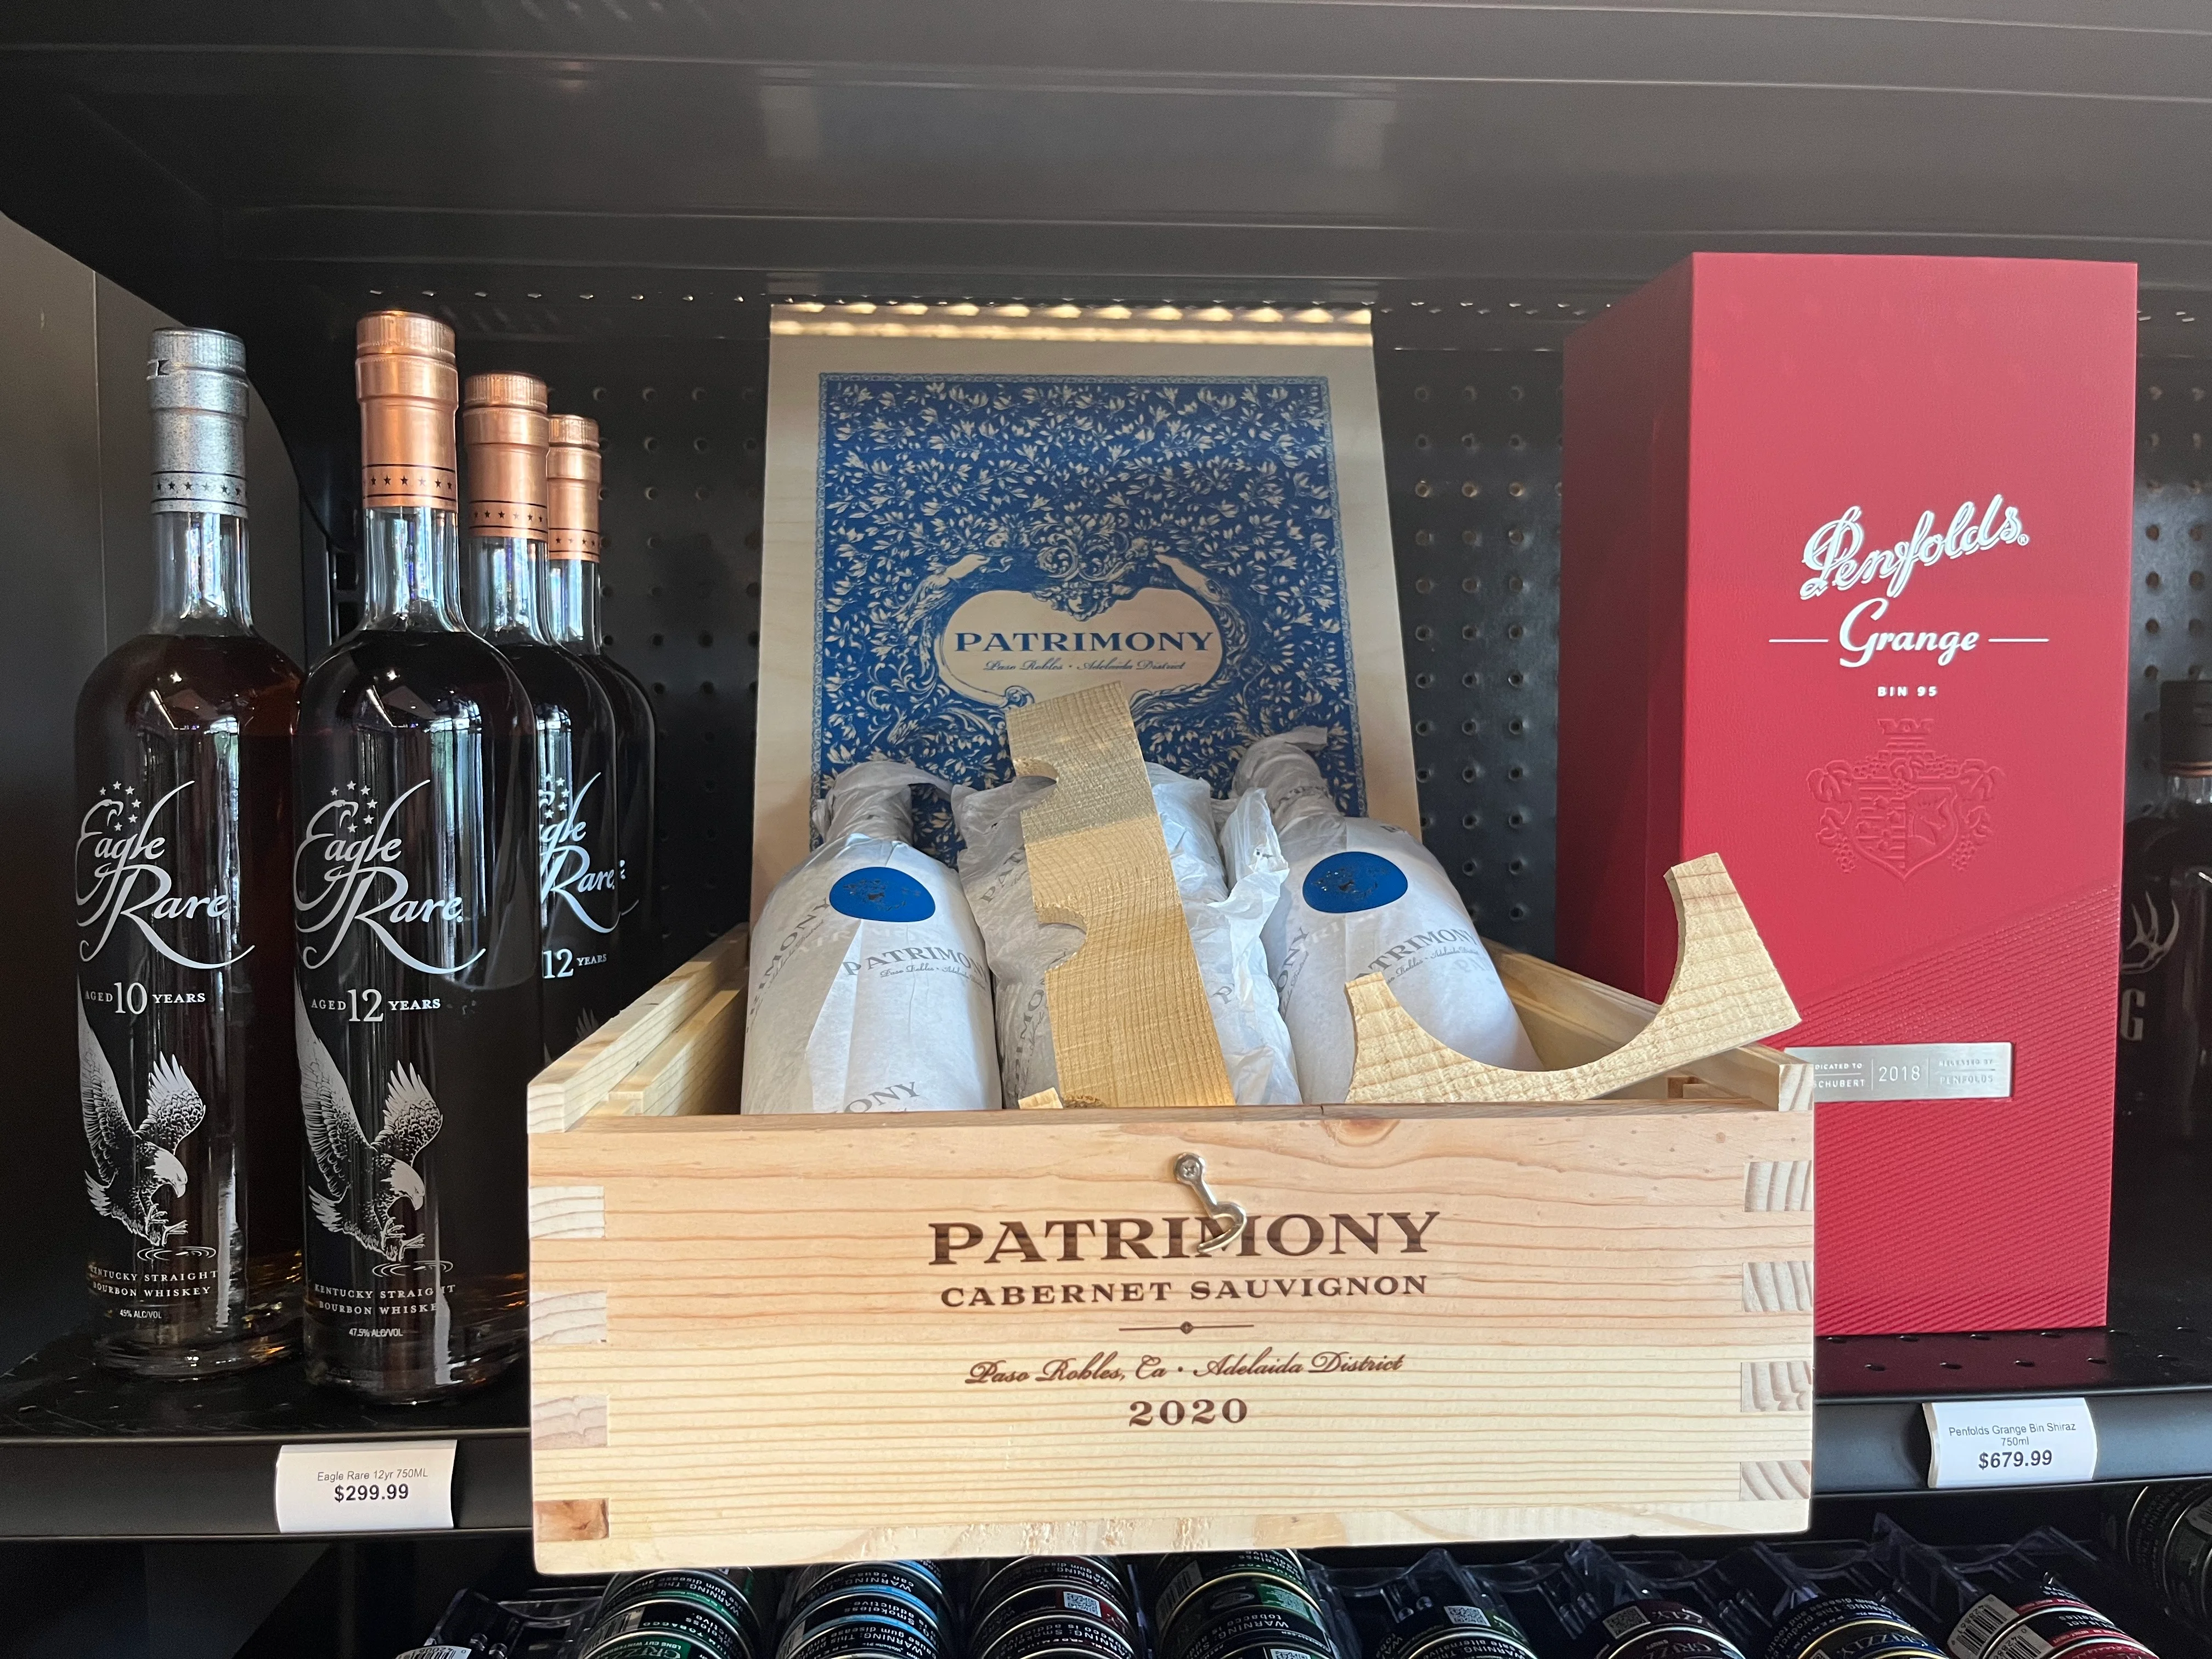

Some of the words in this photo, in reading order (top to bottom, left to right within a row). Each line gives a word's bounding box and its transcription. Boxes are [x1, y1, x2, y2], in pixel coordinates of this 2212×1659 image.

[1799, 493, 2024, 600] Penfolds
[955, 631, 1214, 652] PATRIMONY
[1839, 597, 1980, 668] Grange
[983, 660, 1017, 671] Paso
[1019, 657, 1063, 670] Robles
[1877, 686, 1908, 697] BIN
[1917, 686, 1938, 697] 95
[75, 780, 195, 927] Eagle
[293, 779, 431, 933] Eagle
[80, 864, 256, 969] Rare
[302, 865, 486, 974] Rare
[542, 948, 574, 979] 12
[576, 953, 608, 967] YEARS
[84, 991, 114, 1003] AGED
[114, 981, 148, 1014] 10
[152, 992, 206, 1004] YEARS
[311, 998, 347, 1011] AGED
[347, 989, 384, 1022] 12
[388, 998, 441, 1011] YEARS
[1878, 1065, 1921, 1082] 2018
[1940, 1075, 1993, 1085] PENFOLDS
[927, 1210, 1440, 1266] PATRIMONY
[88, 1263, 138, 1281] KENTUCKY
[144, 1271, 218, 1282] STRAIGHT
[93, 1281, 137, 1296] BOURBON
[144, 1286, 211, 1297] WHISKEY
[314, 1283, 374, 1299] KENTUCKY
[941, 1282, 1172, 1308] CABERNET
[1190, 1275, 1428, 1300] SAUVIGNON
[119, 1308, 132, 1318] 45%
[319, 1300, 373, 1315] BOURBON
[379, 1302, 438, 1315] WHISKE
[965, 1359, 1029, 1385] Paso
[1035, 1351, 1125, 1383] Robles,
[1135, 1355, 1167, 1379] Ca
[1193, 1347, 1305, 1378] Adelaida
[1307, 1351, 1406, 1375] District
[1128, 1398, 1249, 1427] 2020
[1948, 1426, 1990, 1437] Penfolds
[1992, 1425, 2027, 1435] Grange
[2029, 1423, 2045, 1433] Bin
[2047, 1422, 2077, 1432] Shiraz
[2000, 1436, 2030, 1447] 750ml
[1978, 1449, 2053, 1471] $679.99
[317, 1471, 344, 1483] Eagle
[347, 1470, 370, 1480] Rare
[374, 1469, 394, 1481] 12yr
[396, 1468, 429, 1479] 750ML
[334, 1483, 409, 1503] $299.99
[881, 1627, 905, 1638] gum
[860, 1632, 923, 1656] WARNING:
